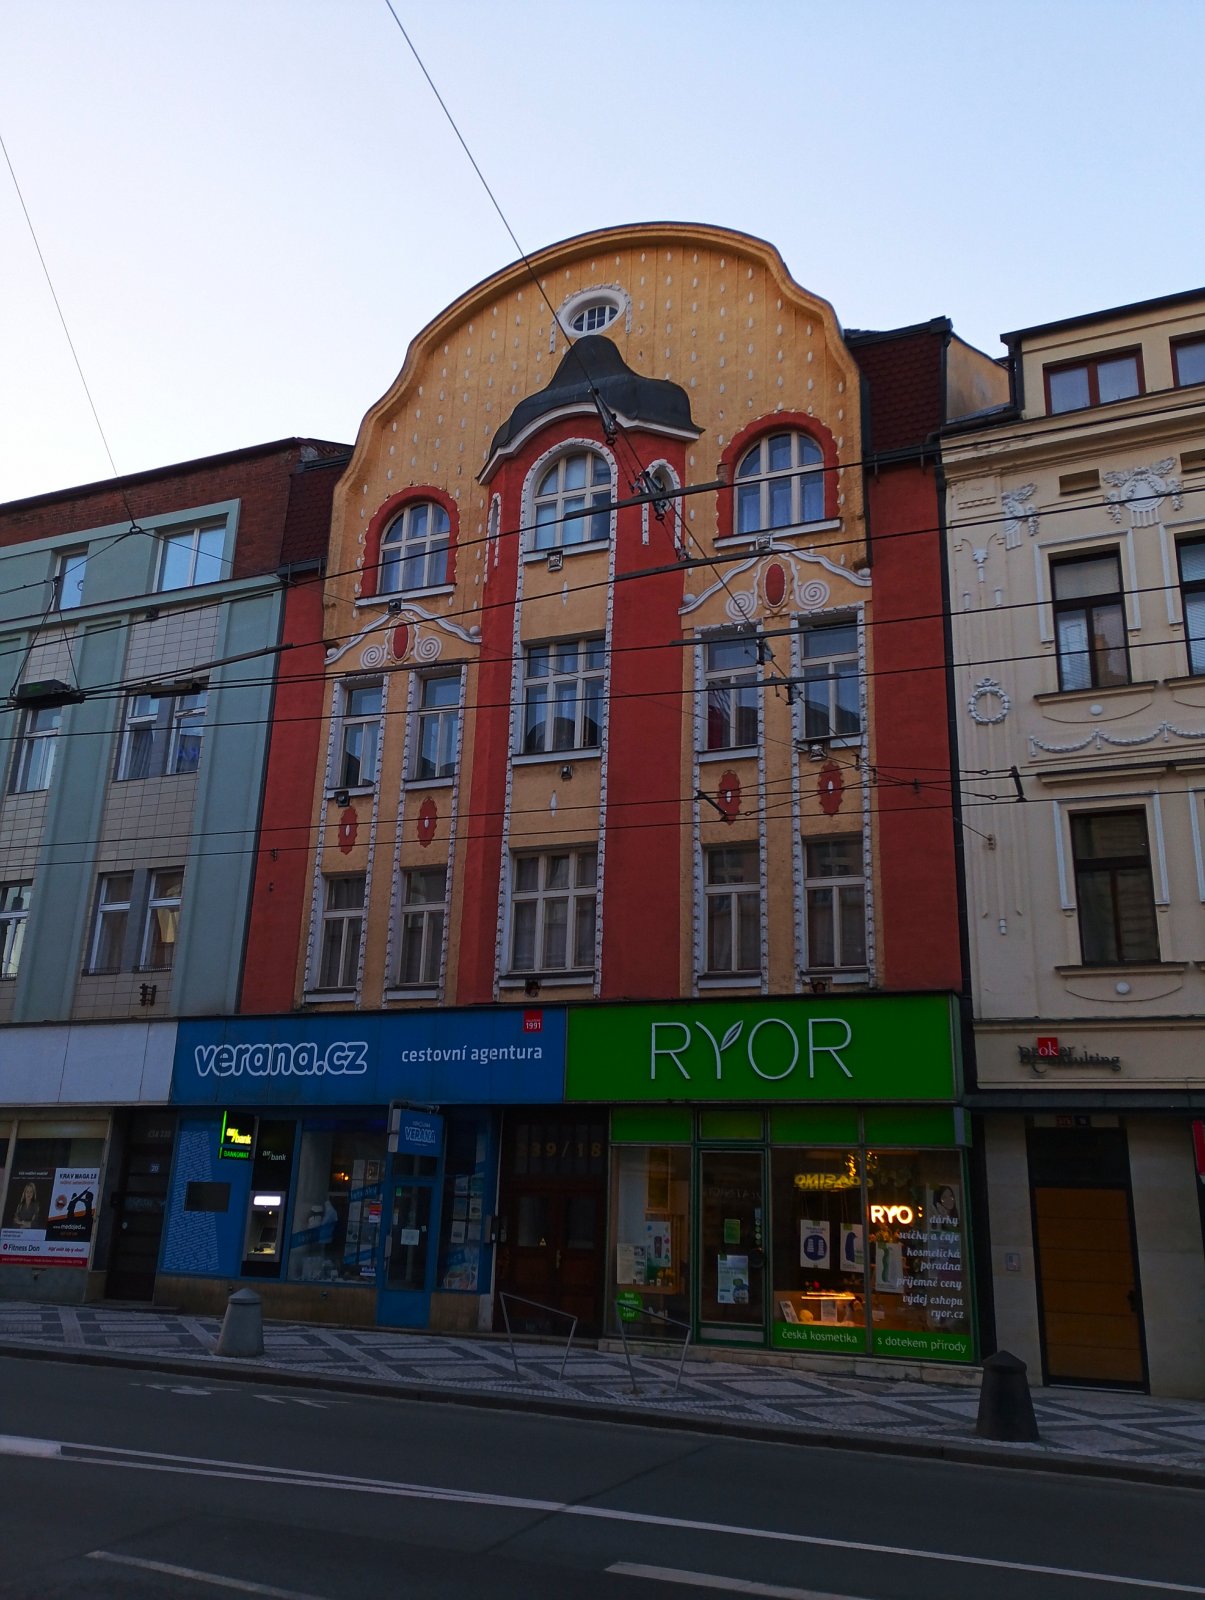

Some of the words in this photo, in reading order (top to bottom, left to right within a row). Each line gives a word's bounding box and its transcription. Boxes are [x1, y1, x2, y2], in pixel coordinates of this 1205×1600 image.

[525, 1022, 541, 1030] 1991
[402, 1045, 467, 1063] cestovní
[471, 1045, 543, 1065] agentura
[650, 1018, 853, 1080] RYOR
[195, 1041, 368, 1077] verana.cz
[223, 1150, 250, 1160] BANKOMAT
[930, 1215, 959, 1227] dárky
[940, 1232, 961, 1244] čaje
[907, 1247, 961, 1259] kosmetická
[920, 1261, 961, 1272] poradna
[896, 1275, 938, 1288] příjemné
[940, 1279, 963, 1291] ceny
[903, 1293, 928, 1307] výdej
[930, 1295, 964, 1307] eshopu
[931, 1310, 964, 1320] ryor.cz
[782, 1327, 808, 1340] česká
[810, 1331, 858, 1344] kosmetika
[877, 1336, 884, 1345] s
[885, 1336, 928, 1349] dotekem
[931, 1340, 967, 1354] přírody
